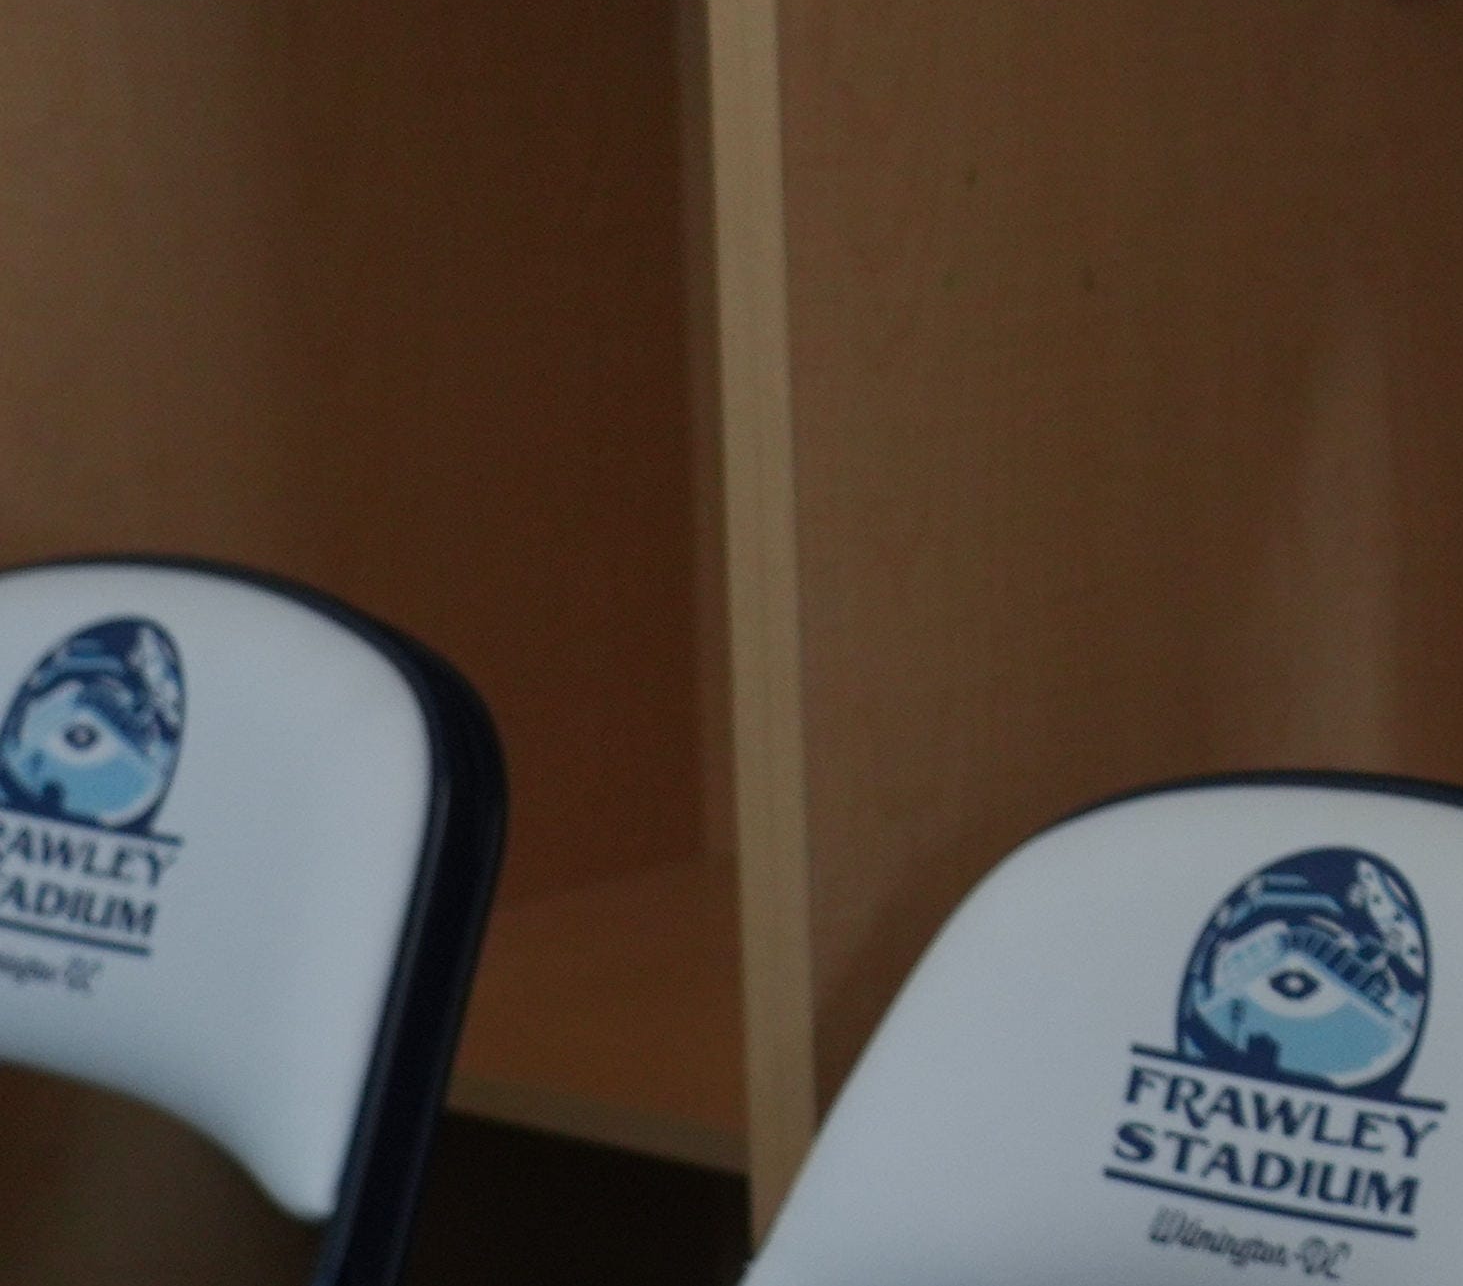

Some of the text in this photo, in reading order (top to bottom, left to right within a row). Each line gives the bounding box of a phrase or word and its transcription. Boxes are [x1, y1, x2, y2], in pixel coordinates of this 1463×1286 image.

[0, 822, 178, 887] AWLEY
[1124, 1065, 1440, 1160] FRAWLEY
[1112, 1122, 1421, 1216] STADIUM
